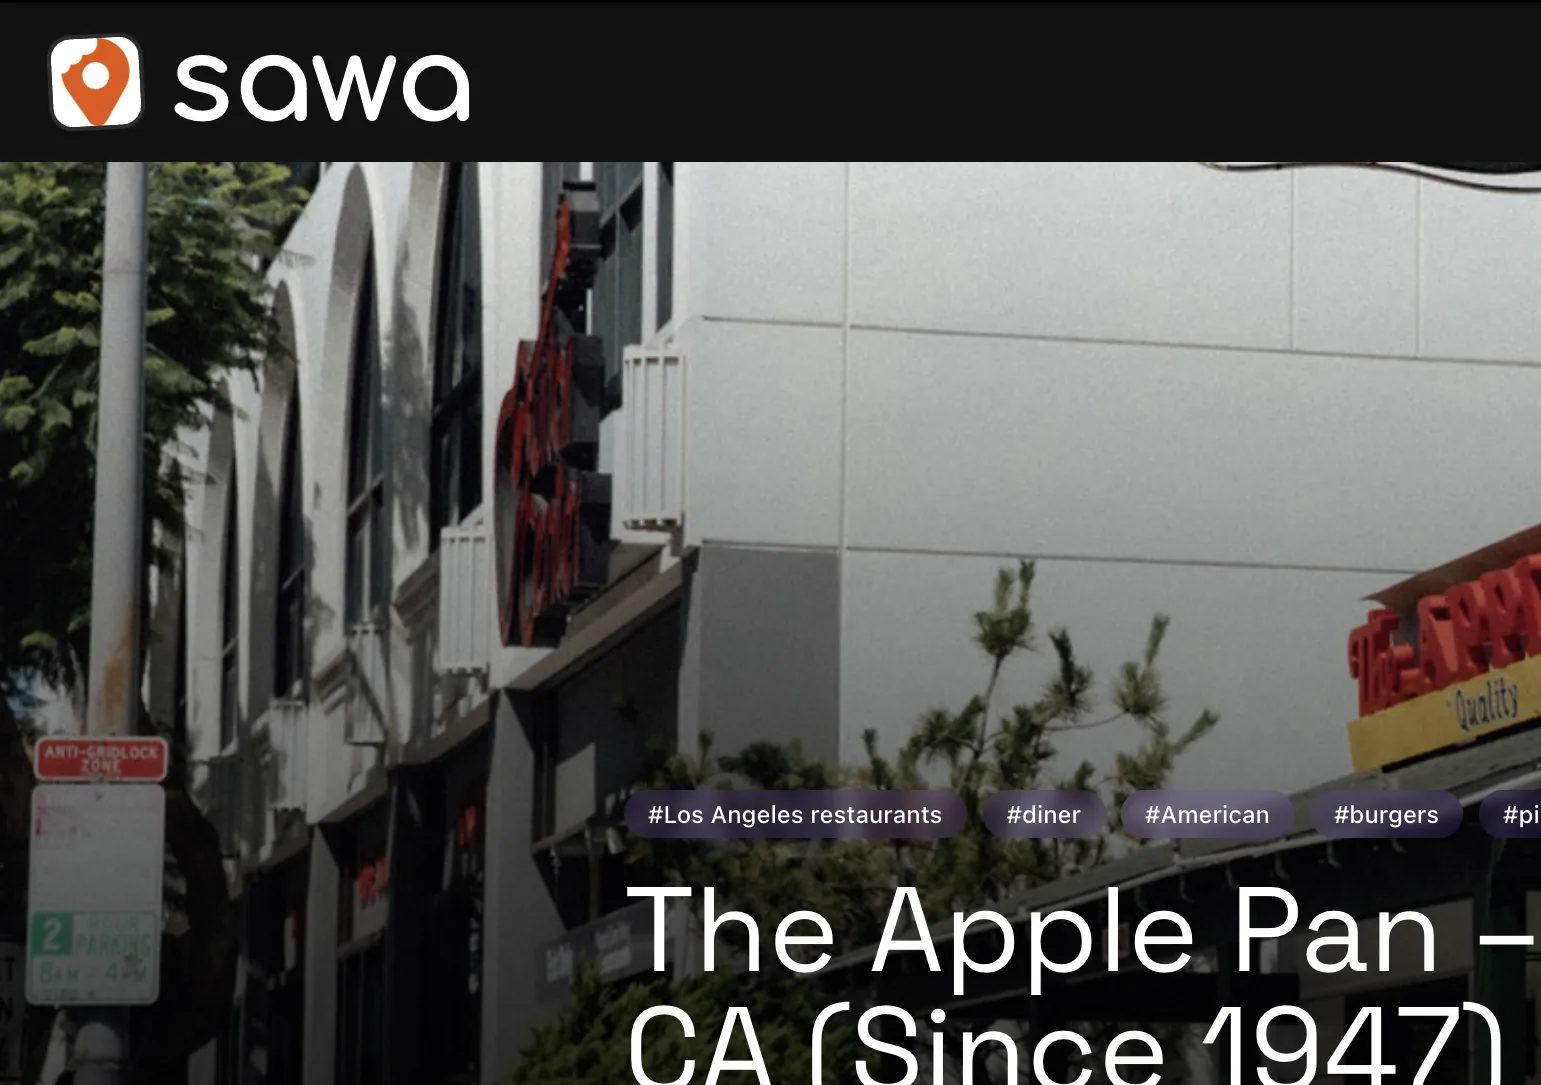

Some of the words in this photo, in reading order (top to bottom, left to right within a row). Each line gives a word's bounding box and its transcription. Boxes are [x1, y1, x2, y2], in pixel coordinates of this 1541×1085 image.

[174, 55, 469, 122] sawa
[44, 744, 158, 760] ANTI-GRIDLOCK
[81, 758, 122, 773] ZONE
[43, 917, 62, 951] 2
[89, 915, 140, 932] HOUR
[77, 933, 152, 956] PARKING
[39, 961, 80, 984] 8AM
